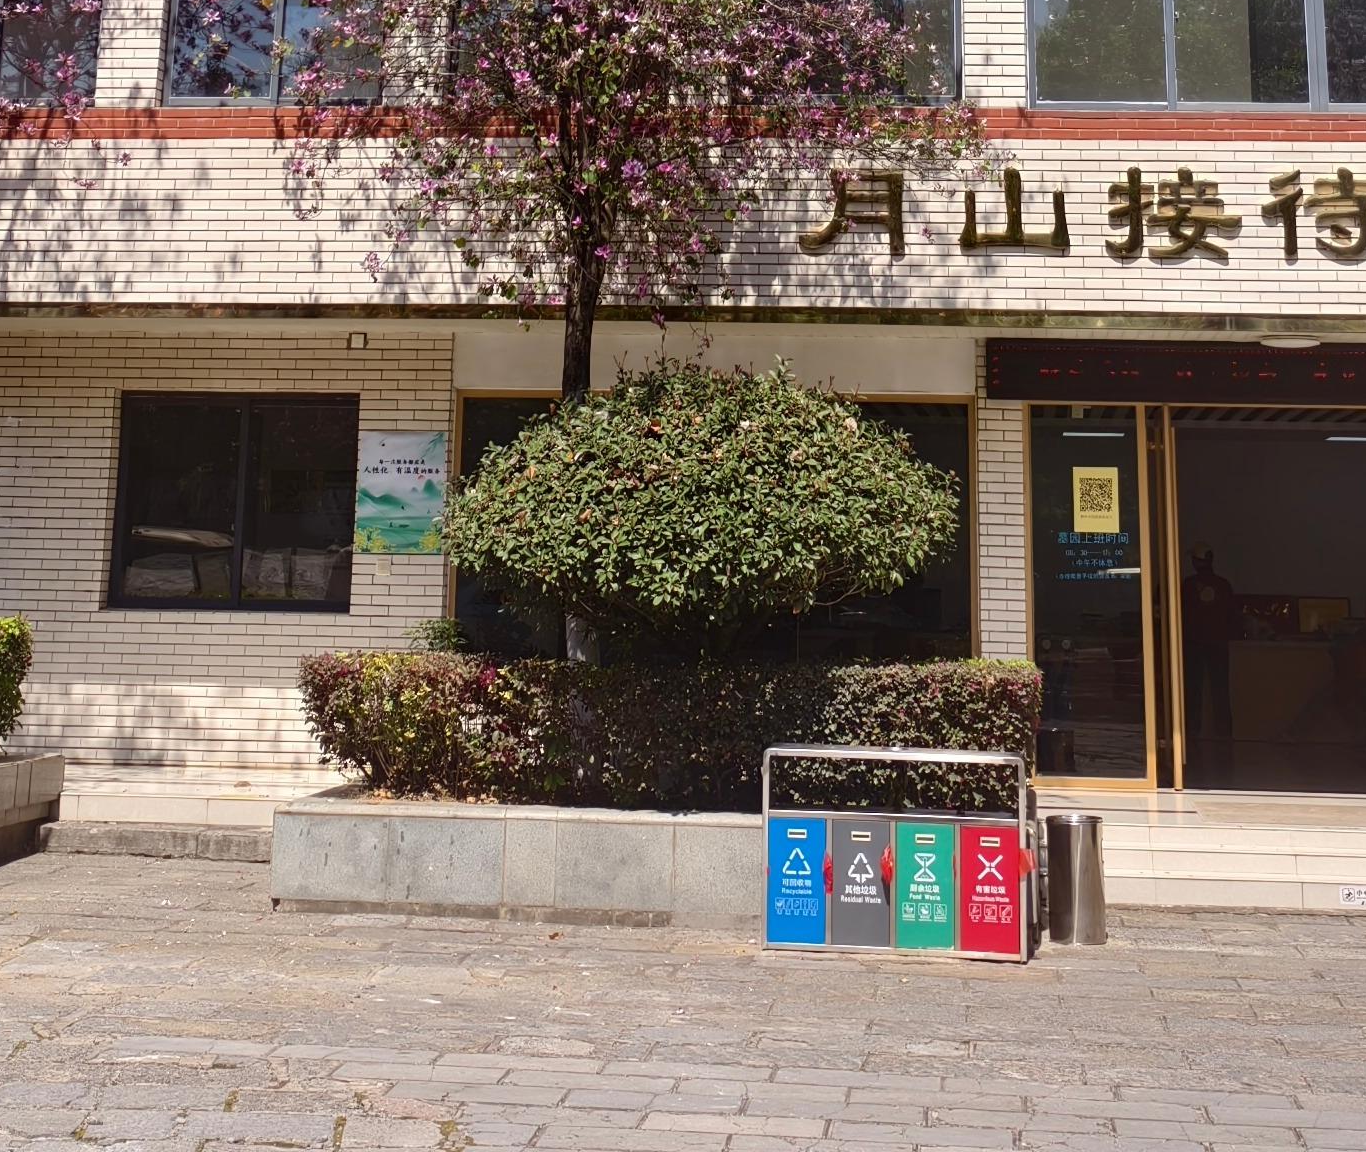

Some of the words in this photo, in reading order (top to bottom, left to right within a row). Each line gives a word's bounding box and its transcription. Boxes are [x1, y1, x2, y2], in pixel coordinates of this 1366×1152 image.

[364, 466, 388, 474] 人性化
[396, 466, 441, 475] 有温度的服务
[782, 878, 812, 887] 可回收物
[845, 885, 877, 895] 其他垃圾
[910, 884, 939, 893] 厨余垃圾
[975, 885, 1006, 894] 有害垃圾
[840, 895, 863, 903] Residual
[865, 896, 881, 904] Waste
